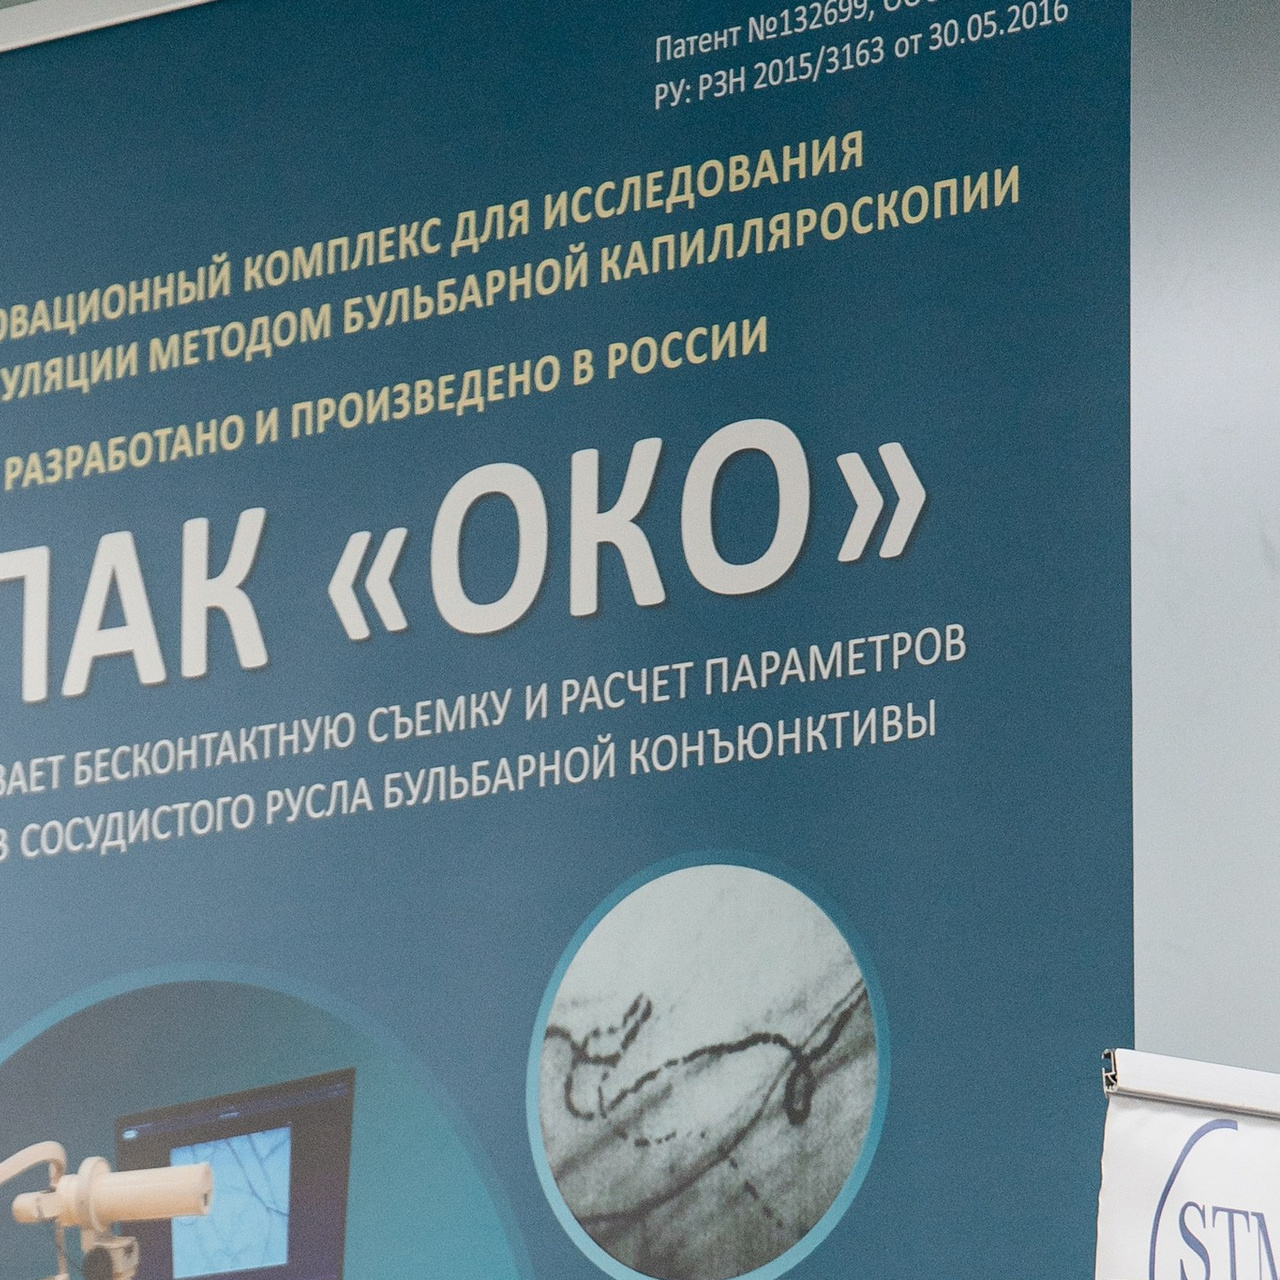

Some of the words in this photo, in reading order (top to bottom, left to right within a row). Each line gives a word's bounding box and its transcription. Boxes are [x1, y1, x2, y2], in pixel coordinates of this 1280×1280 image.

[654, 79, 692, 110] РУ:
[699, 66, 746, 100] РЗН
[753, 36, 885, 89] 2015/3163
[894, 32, 923, 58] от
[928, 0, 1070, 50] 30.05.2016
[655, 25, 741, 63] Патент
[748, 0, 875, 43] №132699,
[148, 303, 332, 373] МЕТОДОМ
[343, 242, 590, 335] БУЛЬБАРНОЙ
[600, 165, 1021, 285] КАПИЛЛЯРОСКОПИИ
[243, 216, 442, 293] КОМПЛЕКС
[451, 198, 530, 256] ДЛЯ
[544, 130, 865, 232] ИССЛЕДОВАНИЯ
[4, 413, 245, 491] РАЗРАБОТАНО
[256, 405, 278, 447] И
[291, 352, 560, 438] ПРОИЗВЕДЕНО
[572, 347, 594, 387] В
[608, 315, 768, 380] РОССИИ
[327, 416, 928, 640] «ОКО»
[19, 793, 257, 860] СОСУДИСТОГО
[266, 776, 373, 826] РУСЛА
[383, 733, 617, 810] БУЛЬБАРНОЙ
[629, 698, 938, 775] КОНЪЮНКТИВЫ
[73, 710, 358, 786] БЕСКОНТАКТНУЮ
[367, 687, 513, 745] СЪЕМКУ
[524, 681, 550, 723] И
[561, 660, 694, 716] РАСЧЕТ
[704, 622, 968, 696] ПАРАМЕТРОВ
